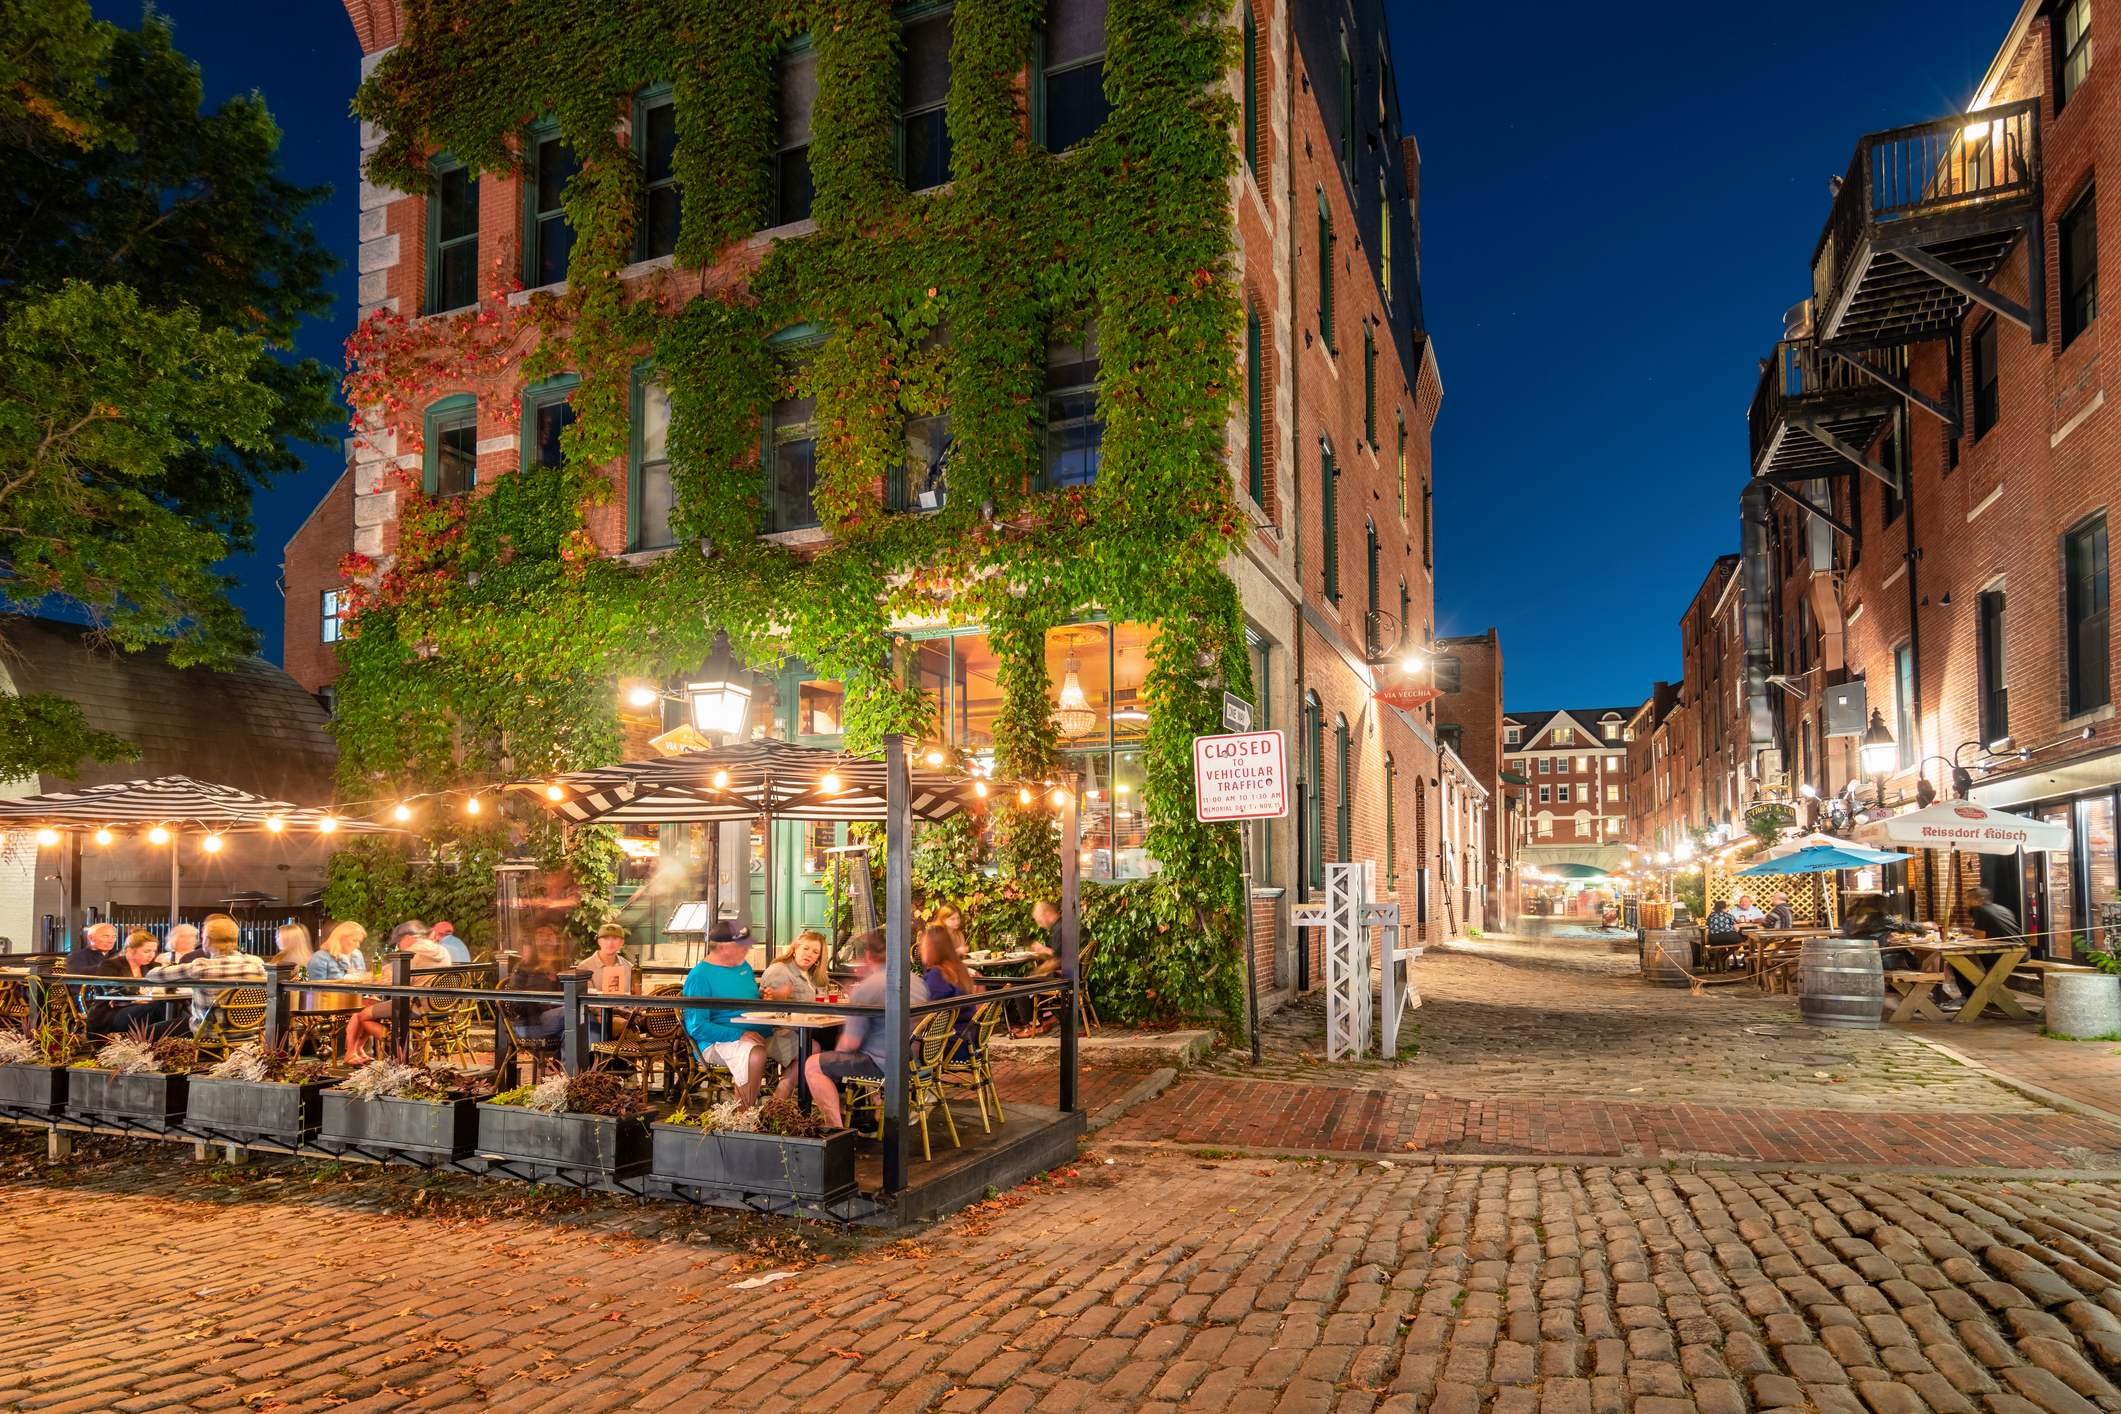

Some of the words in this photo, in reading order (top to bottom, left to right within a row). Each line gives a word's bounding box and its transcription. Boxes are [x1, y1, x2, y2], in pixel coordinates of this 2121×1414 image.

[1204, 740, 1271, 759] CLOSED
[1232, 758, 1244, 767] TO
[1206, 766, 1273, 780] VEHICULAR
[1217, 779, 1264, 792] TRAFFIC
[1203, 805, 1232, 813] MEMORIAL
[1746, 804, 1773, 821] STREET
[1775, 804, 1782, 812] &
[1921, 826, 1980, 838] Reissdorf
[1983, 828, 2027, 843] Kölsch
